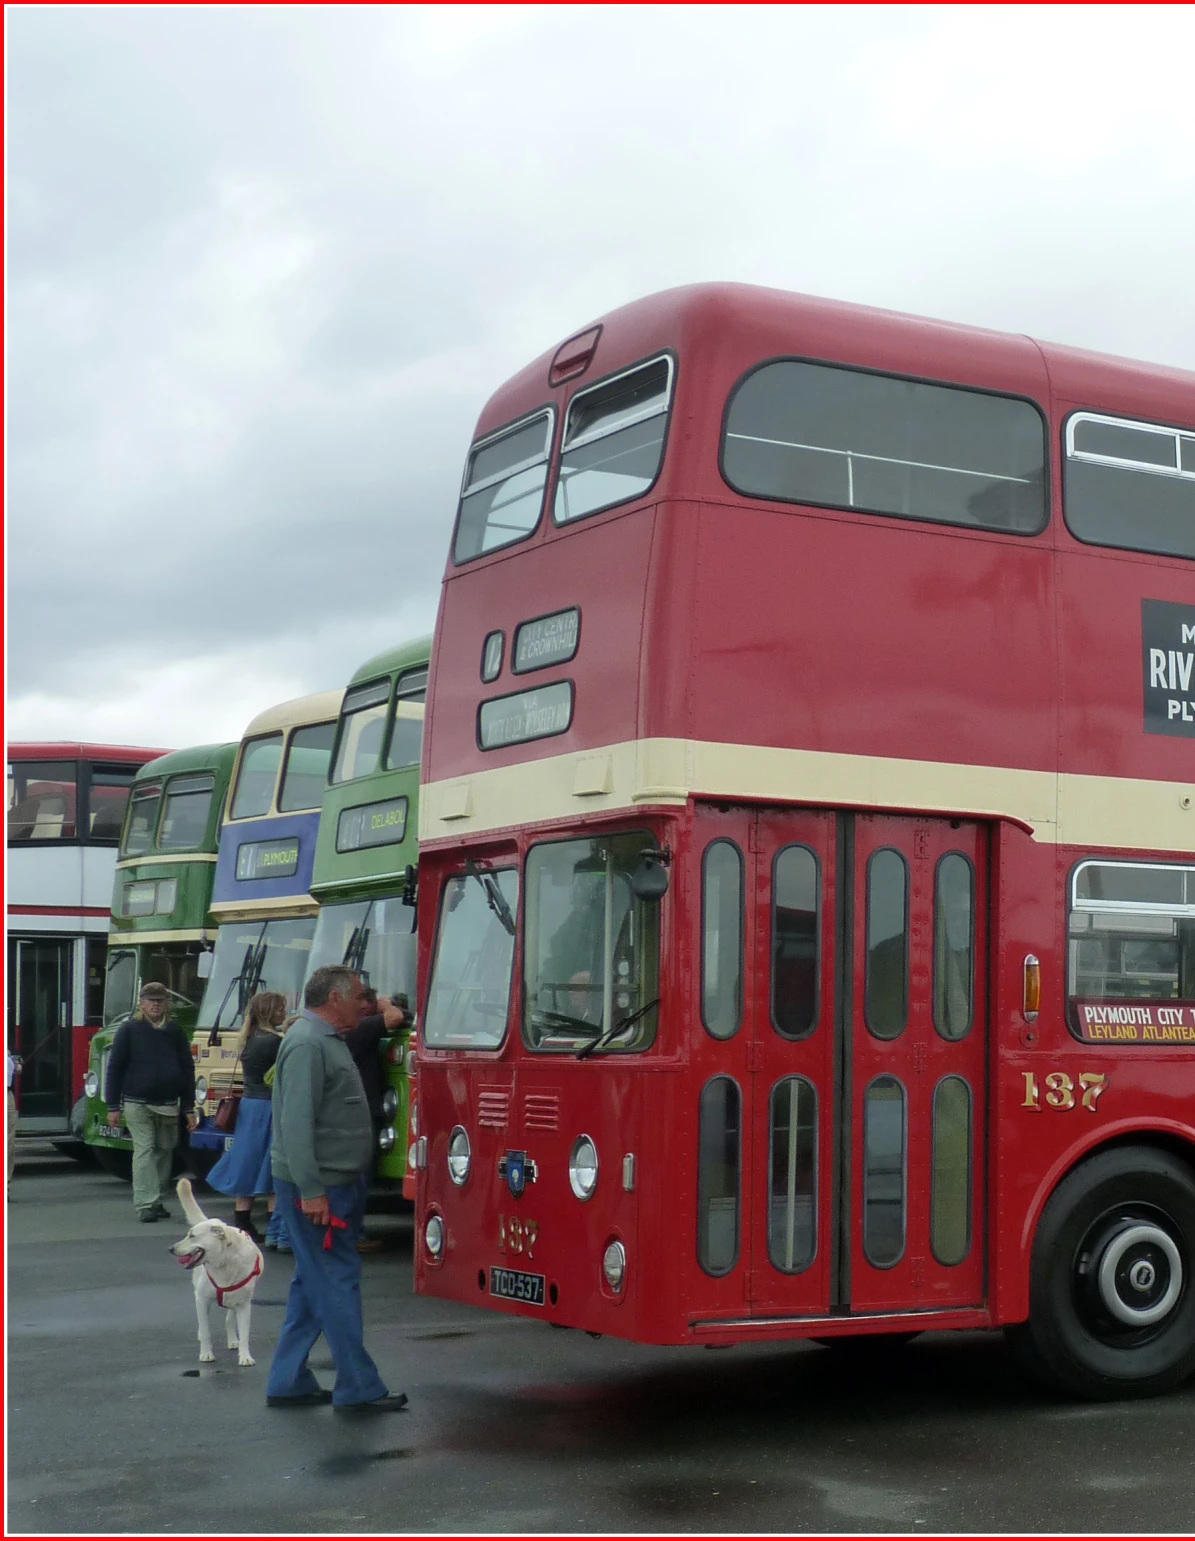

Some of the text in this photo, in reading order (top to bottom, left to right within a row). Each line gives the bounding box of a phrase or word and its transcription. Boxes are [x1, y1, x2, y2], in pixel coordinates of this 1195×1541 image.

[523, 623, 542, 643] CITY
[1084, 1006, 1152, 1025] PLYMOUTH
[1157, 1008, 1183, 1025] CITY
[1087, 1024, 1138, 1040] LEYLAND
[1020, 1071, 1110, 1113] 137
[497, 1212, 540, 1261] 137
